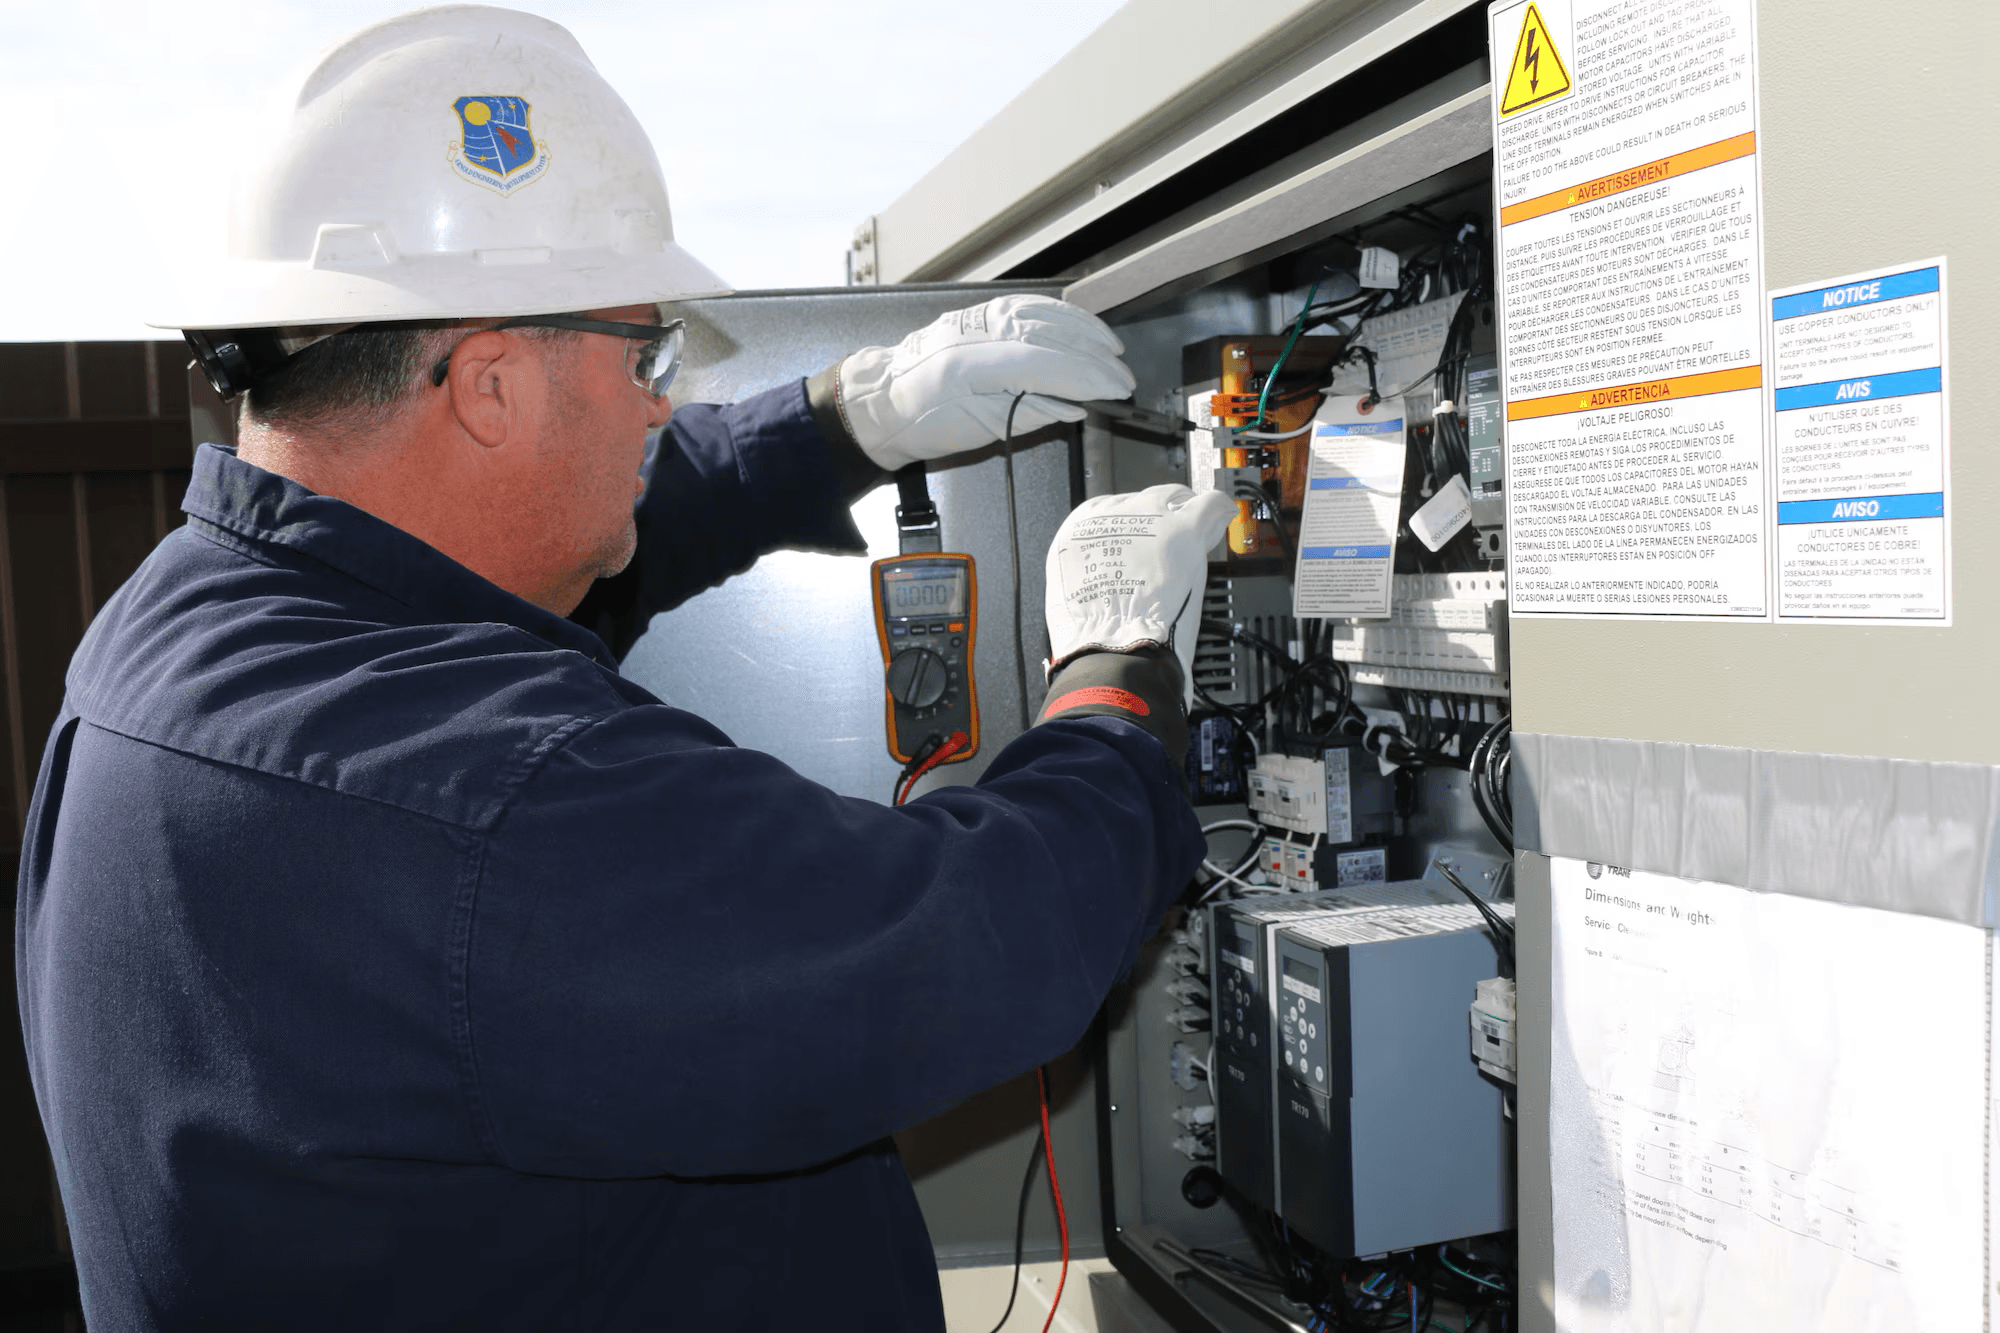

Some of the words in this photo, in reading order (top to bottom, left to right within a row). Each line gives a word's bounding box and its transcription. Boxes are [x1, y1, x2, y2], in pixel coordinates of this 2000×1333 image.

[1578, 76, 1607, 95] STORED
[1501, 121, 1522, 136] SPEED
[1545, 104, 1568, 120] REFER
[1569, 100, 1579, 111] TO
[1580, 92, 1601, 108] DRIVE
[1603, 71, 1658, 99] INSTRUCTIONS
[1659, 64, 1675, 79] FOR
[1502, 148, 1516, 161] LINE
[1517, 143, 1532, 155] SIDE
[1533, 129, 1571, 150] TERMINALS
[1572, 119, 1599, 137] REMAIN
[1601, 104, 1643, 127] ENERGIZED
[1644, 95, 1668, 112] WHEN
[1669, 80, 1711, 103] SWITCHES
[1713, 74, 1730, 89] ARE
[1503, 171, 1530, 188] FAILURE
[1532, 168, 1541, 178] TO
[1542, 164, 1552, 175] DO
[1554, 159, 1567, 171] THE
[1569, 151, 1593, 167] ABOVE
[1595, 142, 1621, 158] COULD
[1622, 131, 1652, 149] RESULT
[1664, 119, 1691, 136] DEATH
[1693, 114, 1705, 127] OR
[1707, 101, 1746, 122] SERIOUS
[1502, 161, 1515, 173] THE
[1516, 157, 1528, 169] OFF
[1578, 162, 1670, 200] AVERTISSEMENT
[1569, 204, 1605, 223] TENSION
[1606, 185, 1670, 213] DANGEREUSE!
[1505, 243, 1532, 258] COUPER
[1534, 235, 1560, 250] TOUTES
[1561, 231, 1574, 243] LES
[1576, 221, 1612, 239] TENSIONS
[1613, 218, 1622, 229] ET
[1624, 210, 1653, 226] OUVRIR
[1654, 205, 1670, 218] LES
[1672, 188, 1736, 214] SECTIONNEURS
[1822, 282, 1880, 308] NOTICE
[1508, 327, 1553, 343] COMPORTANT
[1554, 323, 1568, 334] DES
[1569, 312, 1625, 331] SECTIONNEURS
[1626, 309, 1638, 320] OU
[1639, 306, 1655, 318] DES
[1722, 289, 1739, 302] LES
[1778, 323, 1795, 335] USE
[1797, 317, 1833, 332] COPPER
[1836, 304, 1902, 325] CONDUCTORS
[1509, 350, 1563, 368] INTERRUPTEURS
[1564, 347, 1583, 358] SONT
[1584, 345, 1595, 355] EN
[1596, 338, 1630, 352] POSITION
[1590, 383, 1670, 406] ADVERTENCIA
[1836, 381, 1872, 400] AVIS
[1618, 406, 1673, 423] PELIGROSO!
[1832, 500, 1879, 518] AVISO
[1111, 517, 1155, 525] GLOVE
[1513, 529, 1547, 538] UNIDADES
[1548, 528, 1563, 537] CON
[1564, 525, 1626, 536] DESCONEXIONES
[1627, 524, 1633, 533] O
[1694, 521, 1711, 530] LOS
[1073, 527, 1127, 537] COMPANY
[1080, 539, 1108, 552] SINCE
[1102, 547, 1122, 557] 999
[1085, 563, 1097, 574] 10
[1082, 573, 1108, 584] CLASS
[1515, 581, 1523, 589] EL
[1524, 581, 1534, 589] NO
[1535, 581, 1569, 589] REALIZAR
[1570, 581, 1580, 589] LO
[1581, 581, 1643, 589] ANTERIORMENTE
[1066, 583, 1099, 602] LEATHER
[1100, 580, 1146, 588] PROTECTOR
[1077, 593, 1099, 604] WEAR
[1099, 588, 1118, 598] OVER
[1515, 594, 1554, 602] OCASIONAR
[1555, 594, 1565, 602] LA
[1566, 594, 1595, 602] MUERTE
[1596, 594, 1602, 602] O
[1632, 594, 1671, 603] LESIONES
[1672, 594, 1729, 603] PERSONALES.
[1103, 597, 1110, 608] 9
[1585, 888, 1642, 911] Dimensions
[1670, 905, 1718, 926] Wights
[1584, 916, 1614, 930] Servic
[1291, 1100, 1309, 1119] TR170
[1636, 1192, 1651, 1204] panel
[1651, 1197, 1671, 1207] doors
[1704, 1216, 1716, 1224] not
[1640, 1202, 1646, 1210] of
[1647, 1204, 1660, 1215] fans
[1643, 1214, 1666, 1227] needed
